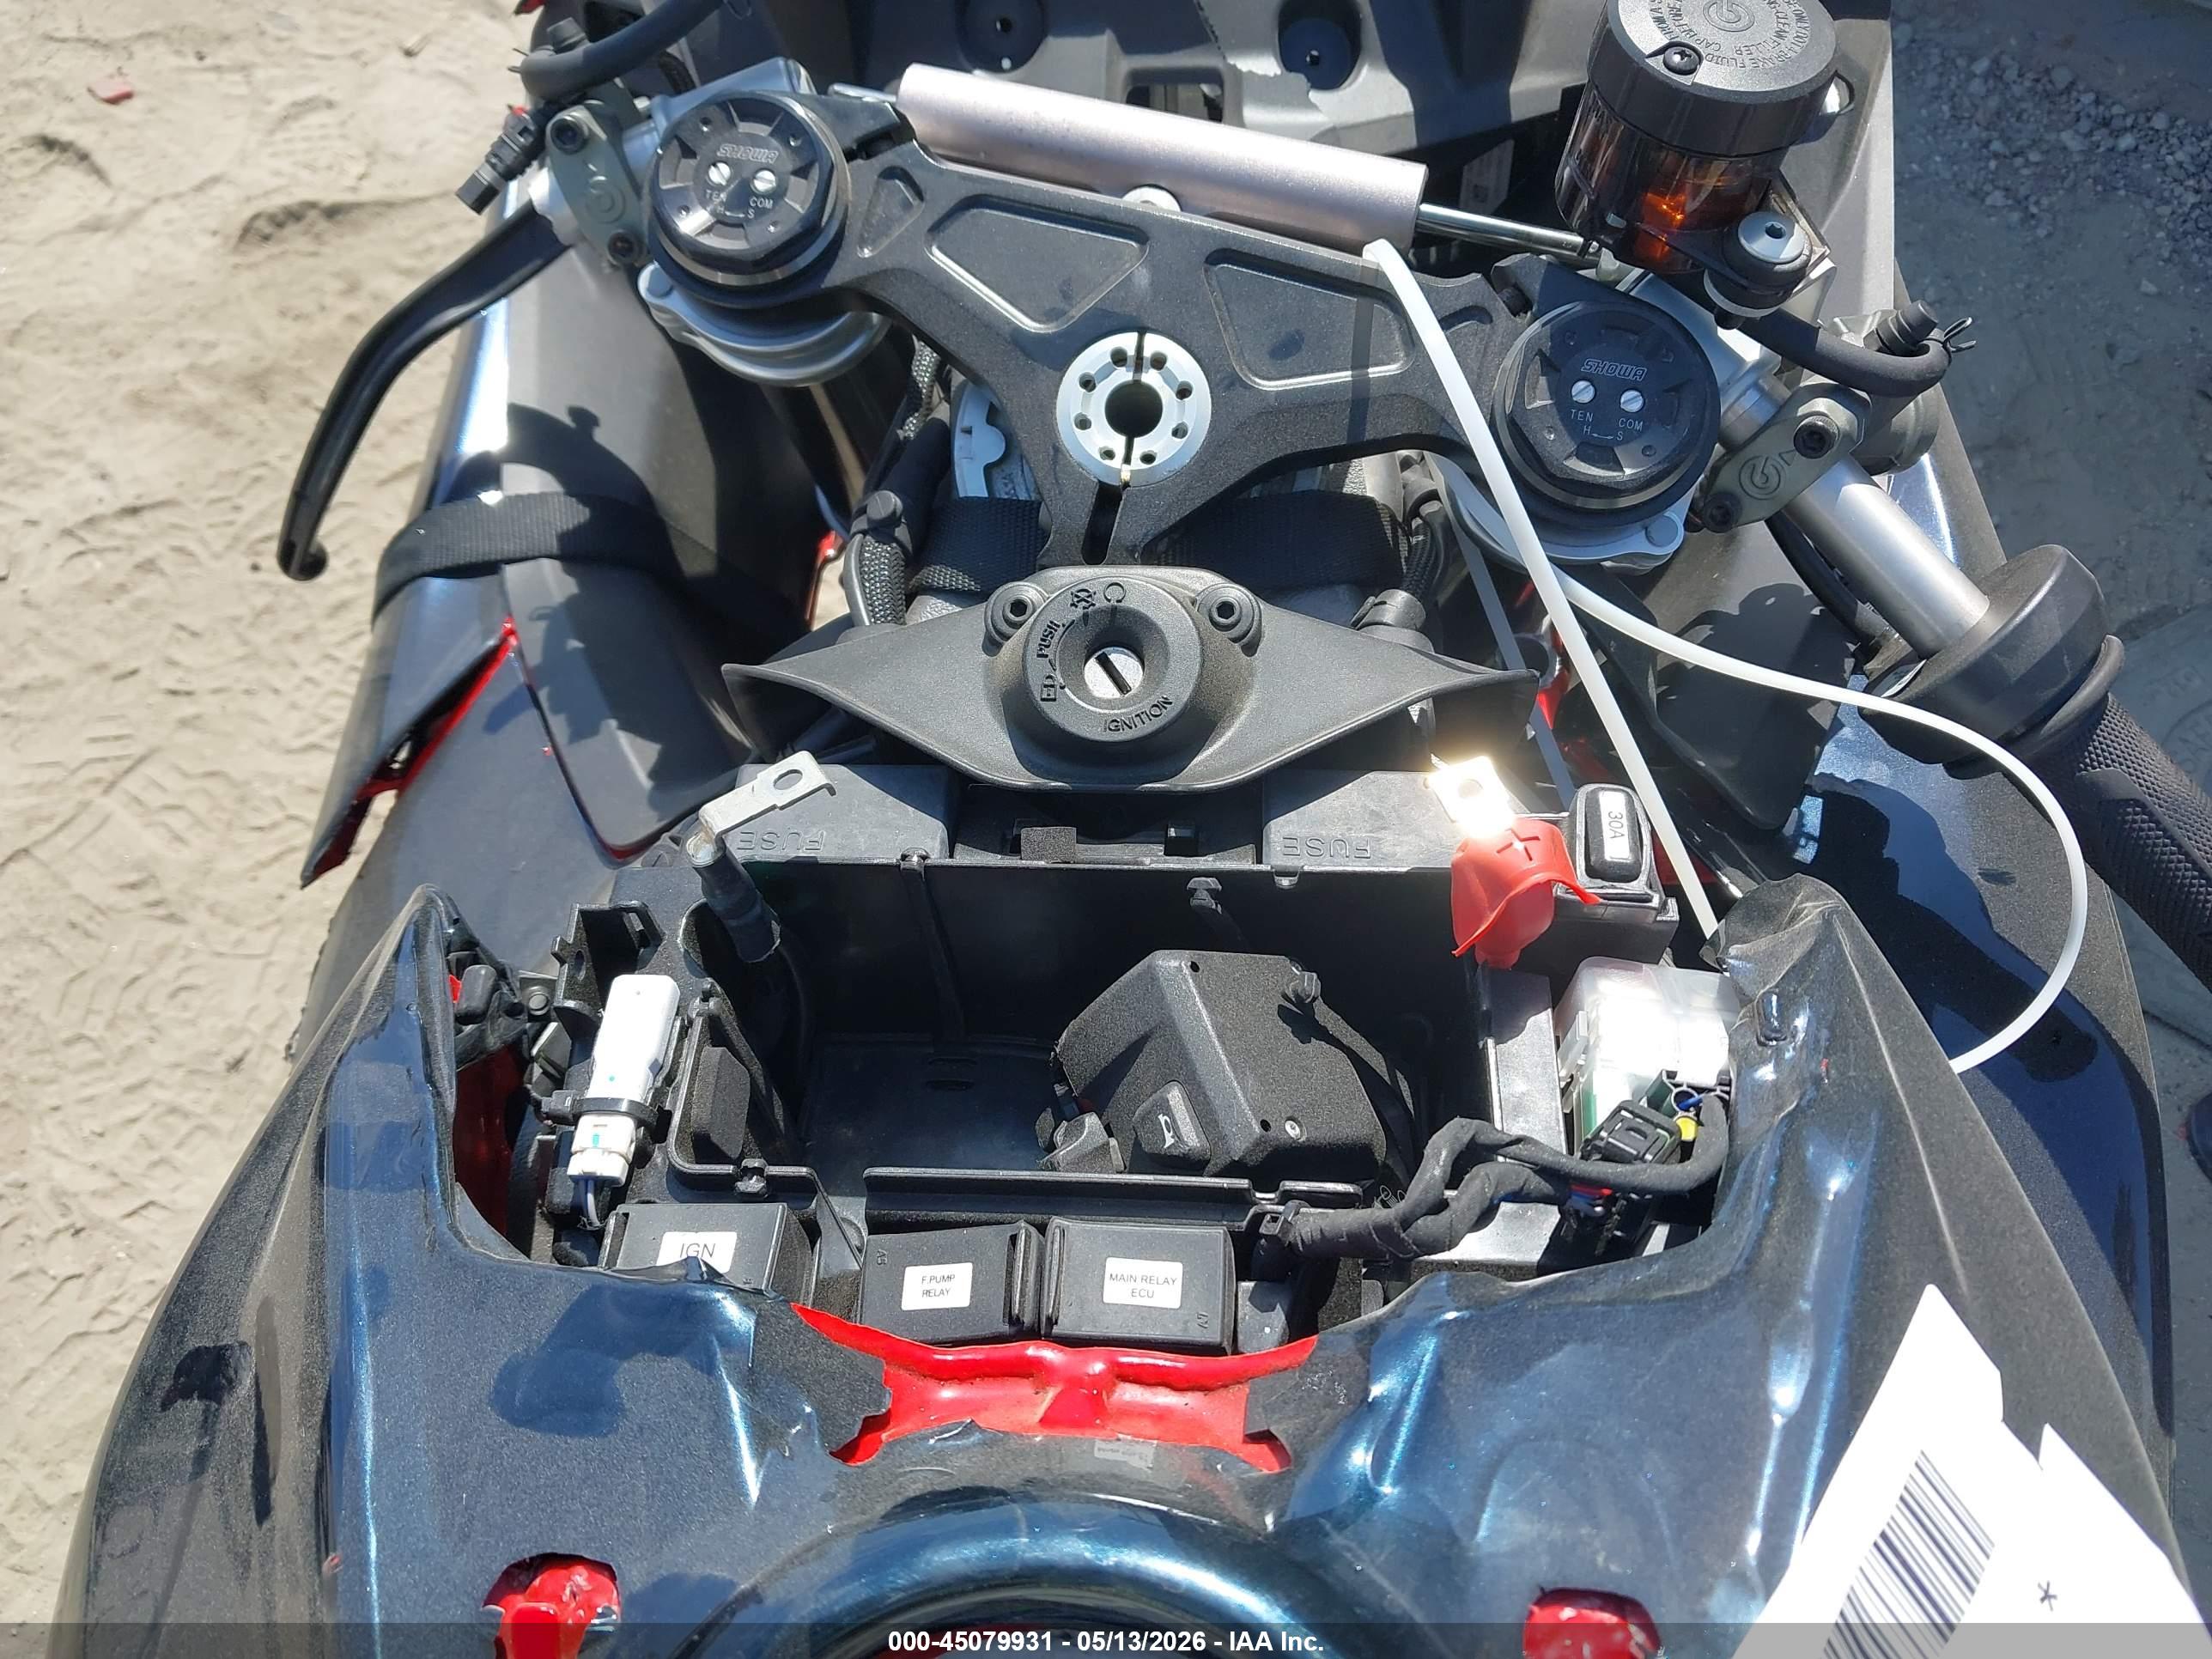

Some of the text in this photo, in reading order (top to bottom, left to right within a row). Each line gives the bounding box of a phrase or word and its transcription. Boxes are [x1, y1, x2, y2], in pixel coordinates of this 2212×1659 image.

[1650, 15, 1680, 41] FROM
[1694, 37, 1722, 52] CAP
[1705, 52, 1747, 69] FLUID
[1748, 49, 1792, 69] BRAKE
[716, 143, 780, 164] SHOWA
[749, 196, 775, 210] COM
[747, 208, 756, 219] S
[1580, 358, 1648, 381] SHOWA
[1571, 409, 1644, 432] TEN COM
[1583, 425, 1624, 441] H S
[1036, 620, 1061, 659] PUSH
[1103, 695, 1174, 732] IGNITION
[1607, 811, 1625, 839] 30A
[737, 830, 825, 851] FUSE
[1282, 836, 1371, 860] FUSE
[679, 1243, 716, 1258] IGN
[1109, 1273, 1178, 1285] MAIN RELAY
[921, 1287, 951, 1298] RELAY
[1131, 1287, 1155, 1299] ECU
